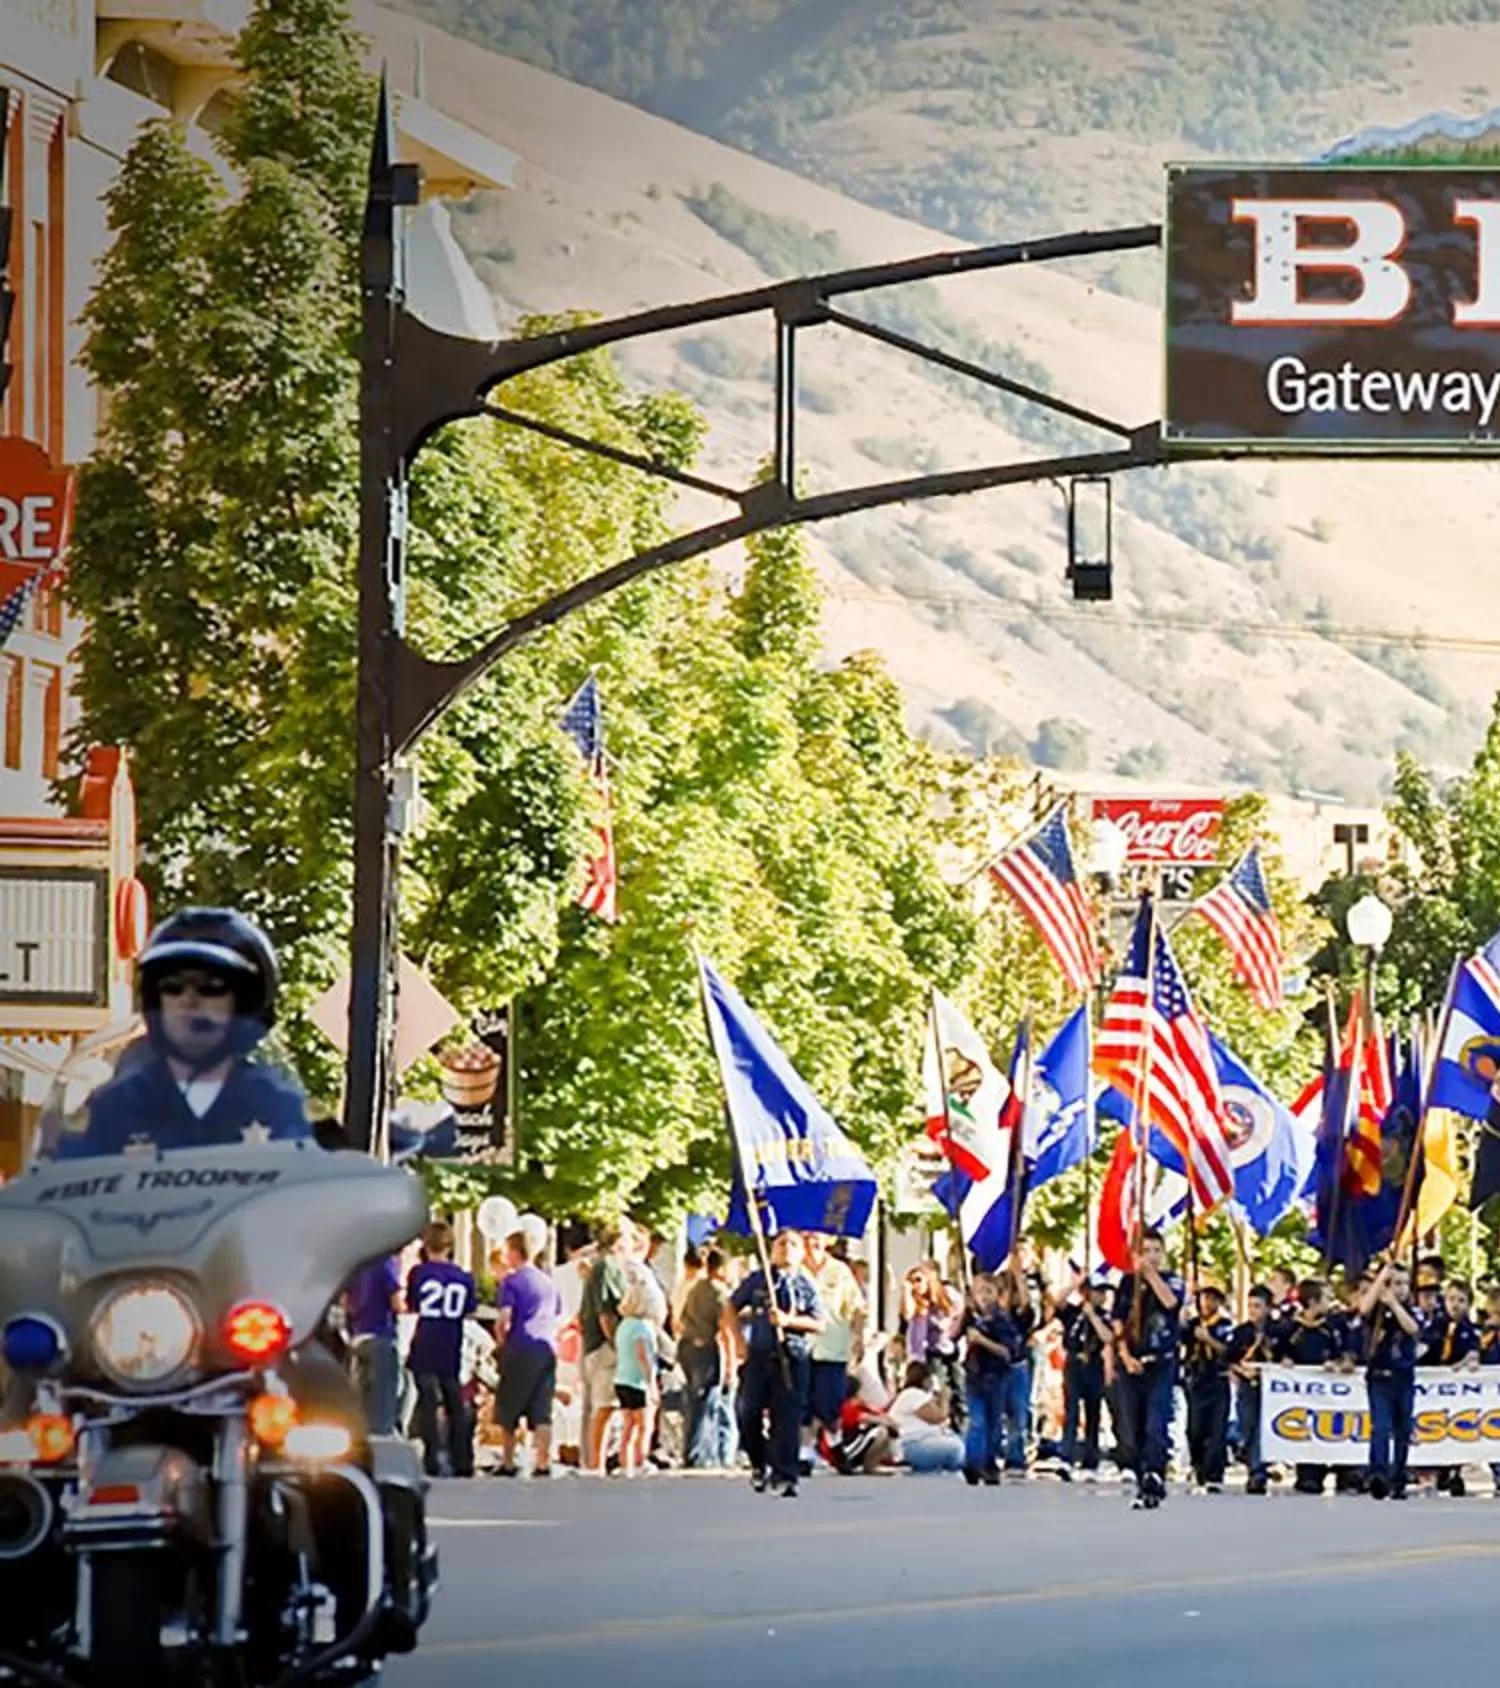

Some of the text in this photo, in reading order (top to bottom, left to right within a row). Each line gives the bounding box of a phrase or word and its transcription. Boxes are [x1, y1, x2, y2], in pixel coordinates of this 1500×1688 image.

[136, 1168, 281, 1192] TROOPER
[420, 1279, 468, 1318] 20
[1270, 1380, 1352, 1396] BIRD
